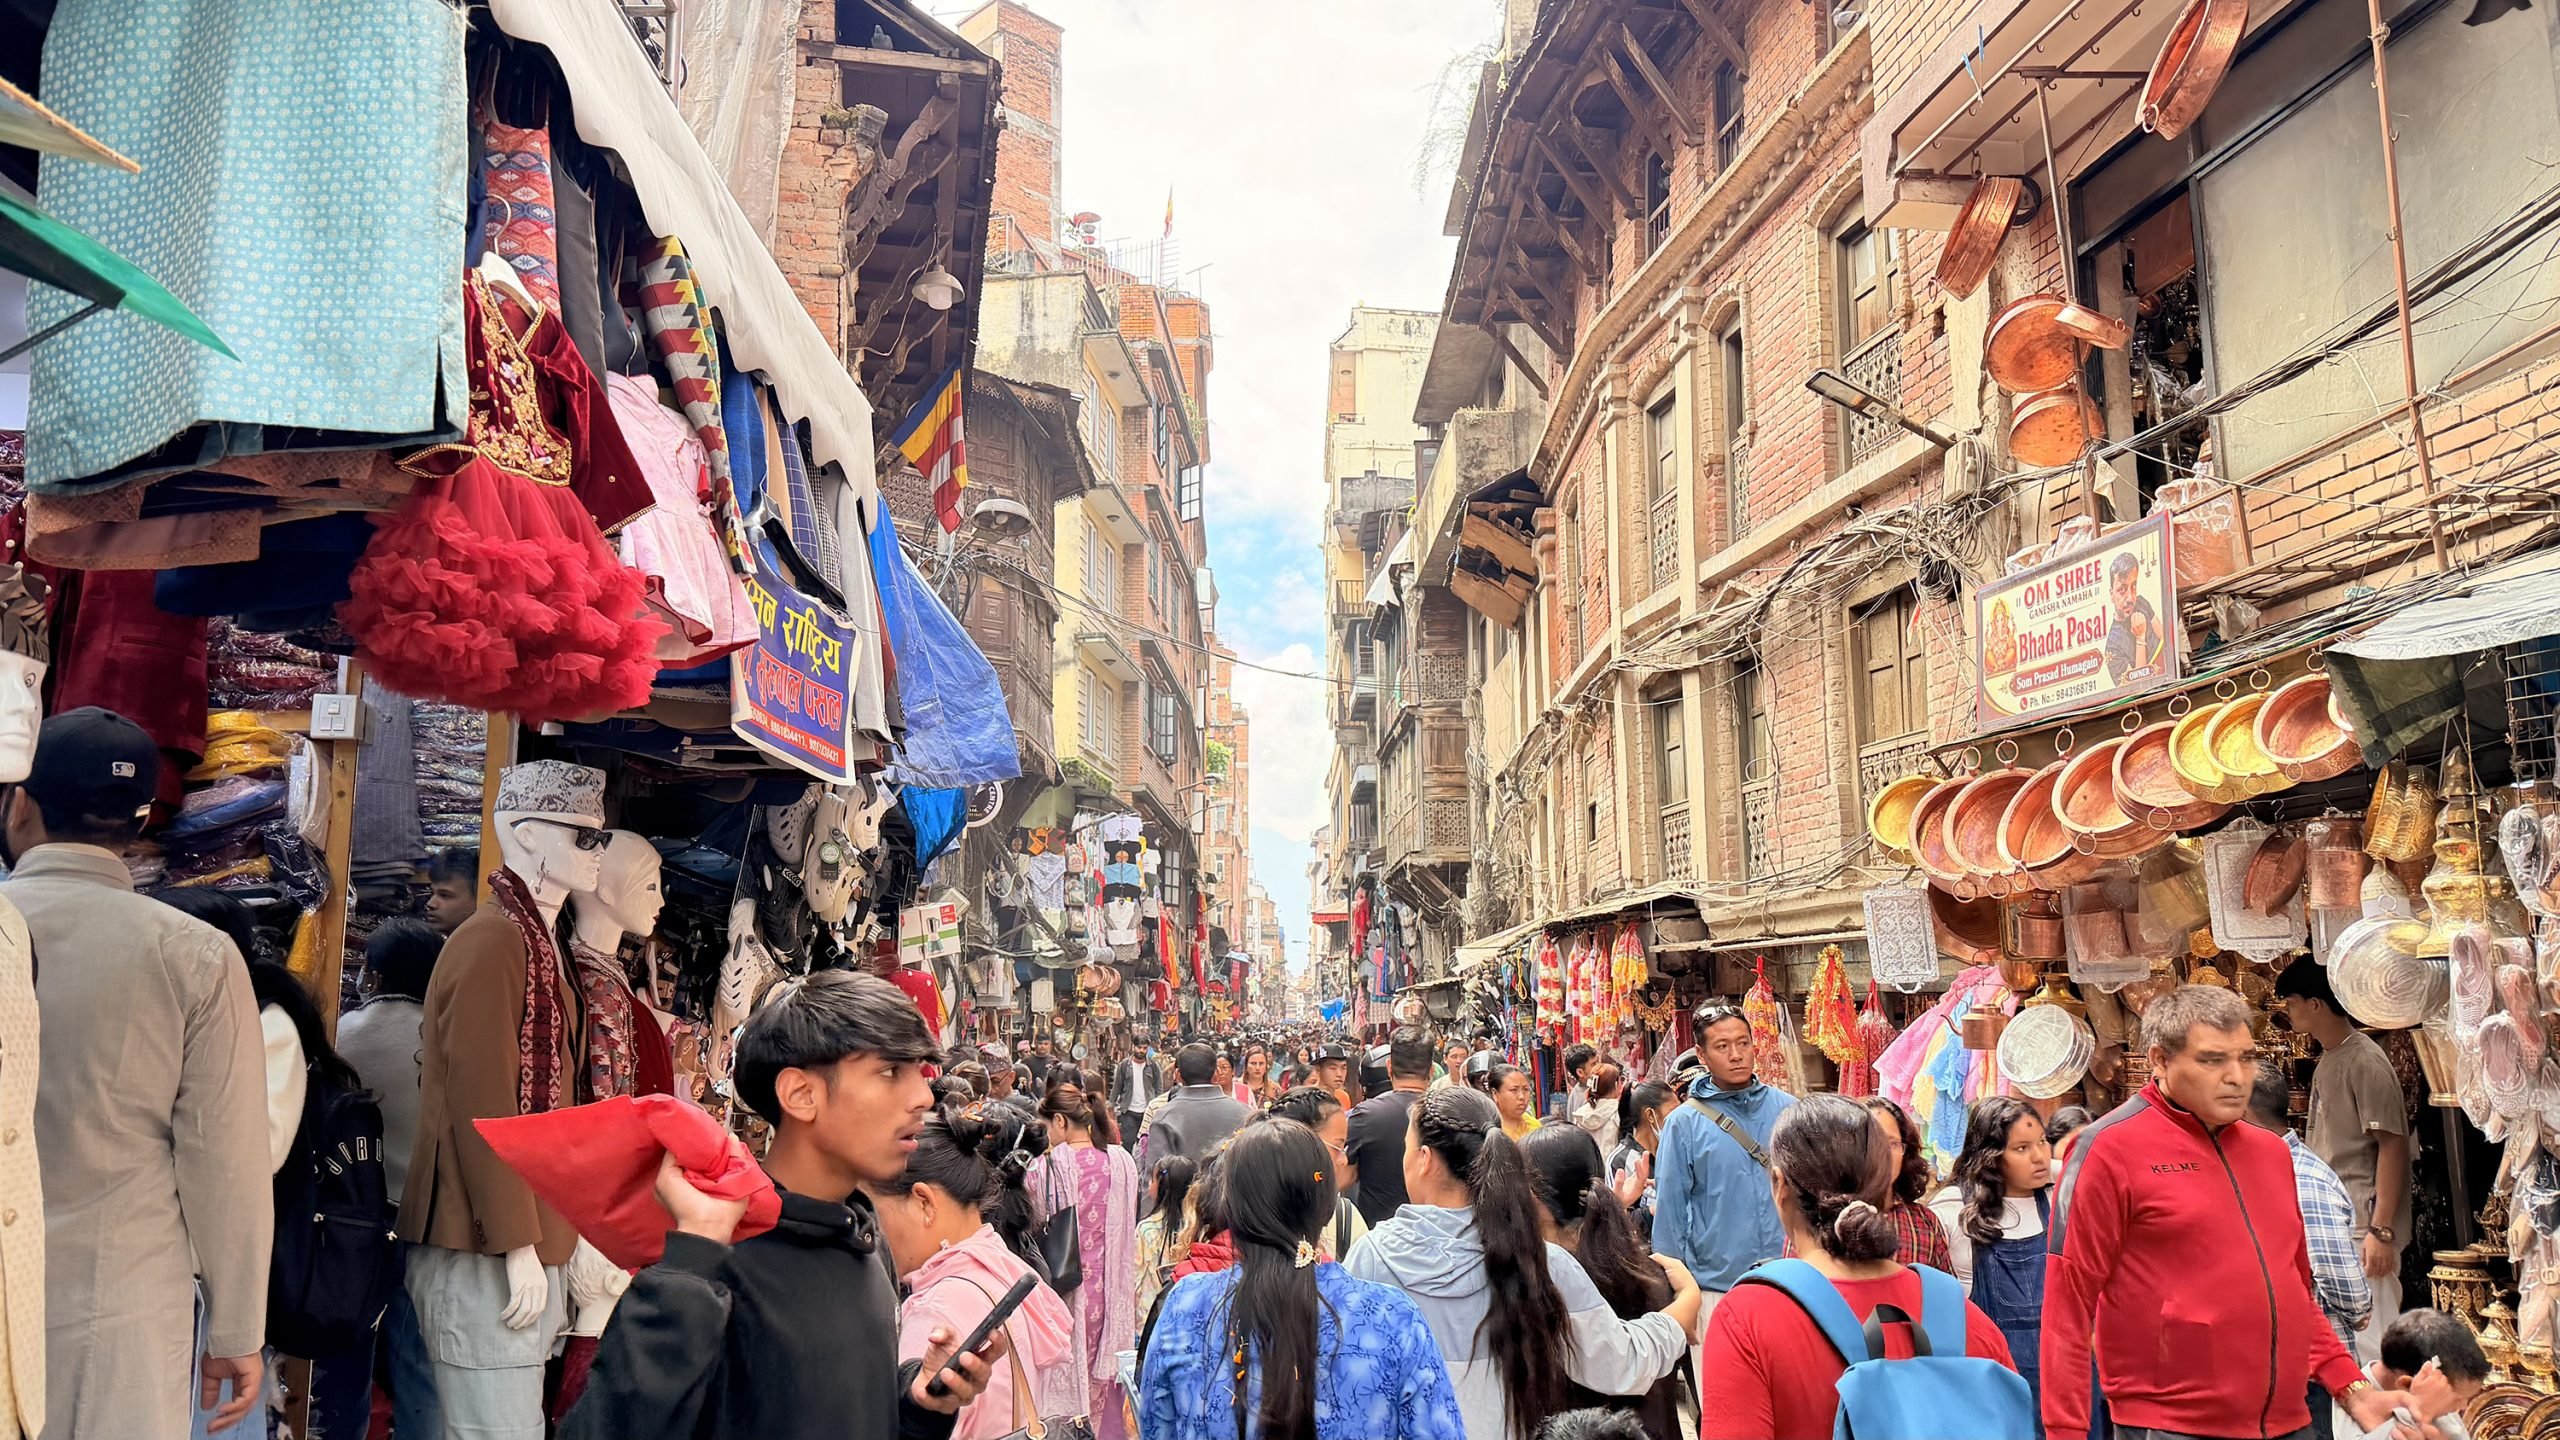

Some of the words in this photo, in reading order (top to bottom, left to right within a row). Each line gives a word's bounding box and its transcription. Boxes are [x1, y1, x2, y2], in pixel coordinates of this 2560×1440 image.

[2024, 580, 2050, 608] OM
[2055, 559, 2103, 597] SHREE
[2029, 601, 2061, 620] GANESHA
[2062, 589, 2093, 607] NAMAHA
[2019, 623, 2063, 663] Bhada
[2066, 604, 2107, 648] Pasal
[2016, 676, 2033, 690] Som
[2034, 666, 2059, 683] Prasad
[2061, 656, 2099, 677] Humagain
[2128, 667, 2150, 680] OWNER
[804, 677, 843, 731] पसल
[2029, 697, 2039, 708] Ph.
[2056, 680, 2097, 700] 9843168791
[984, 786, 996, 814] CENTRE
[2151, 1162, 2201, 1174] KELME
